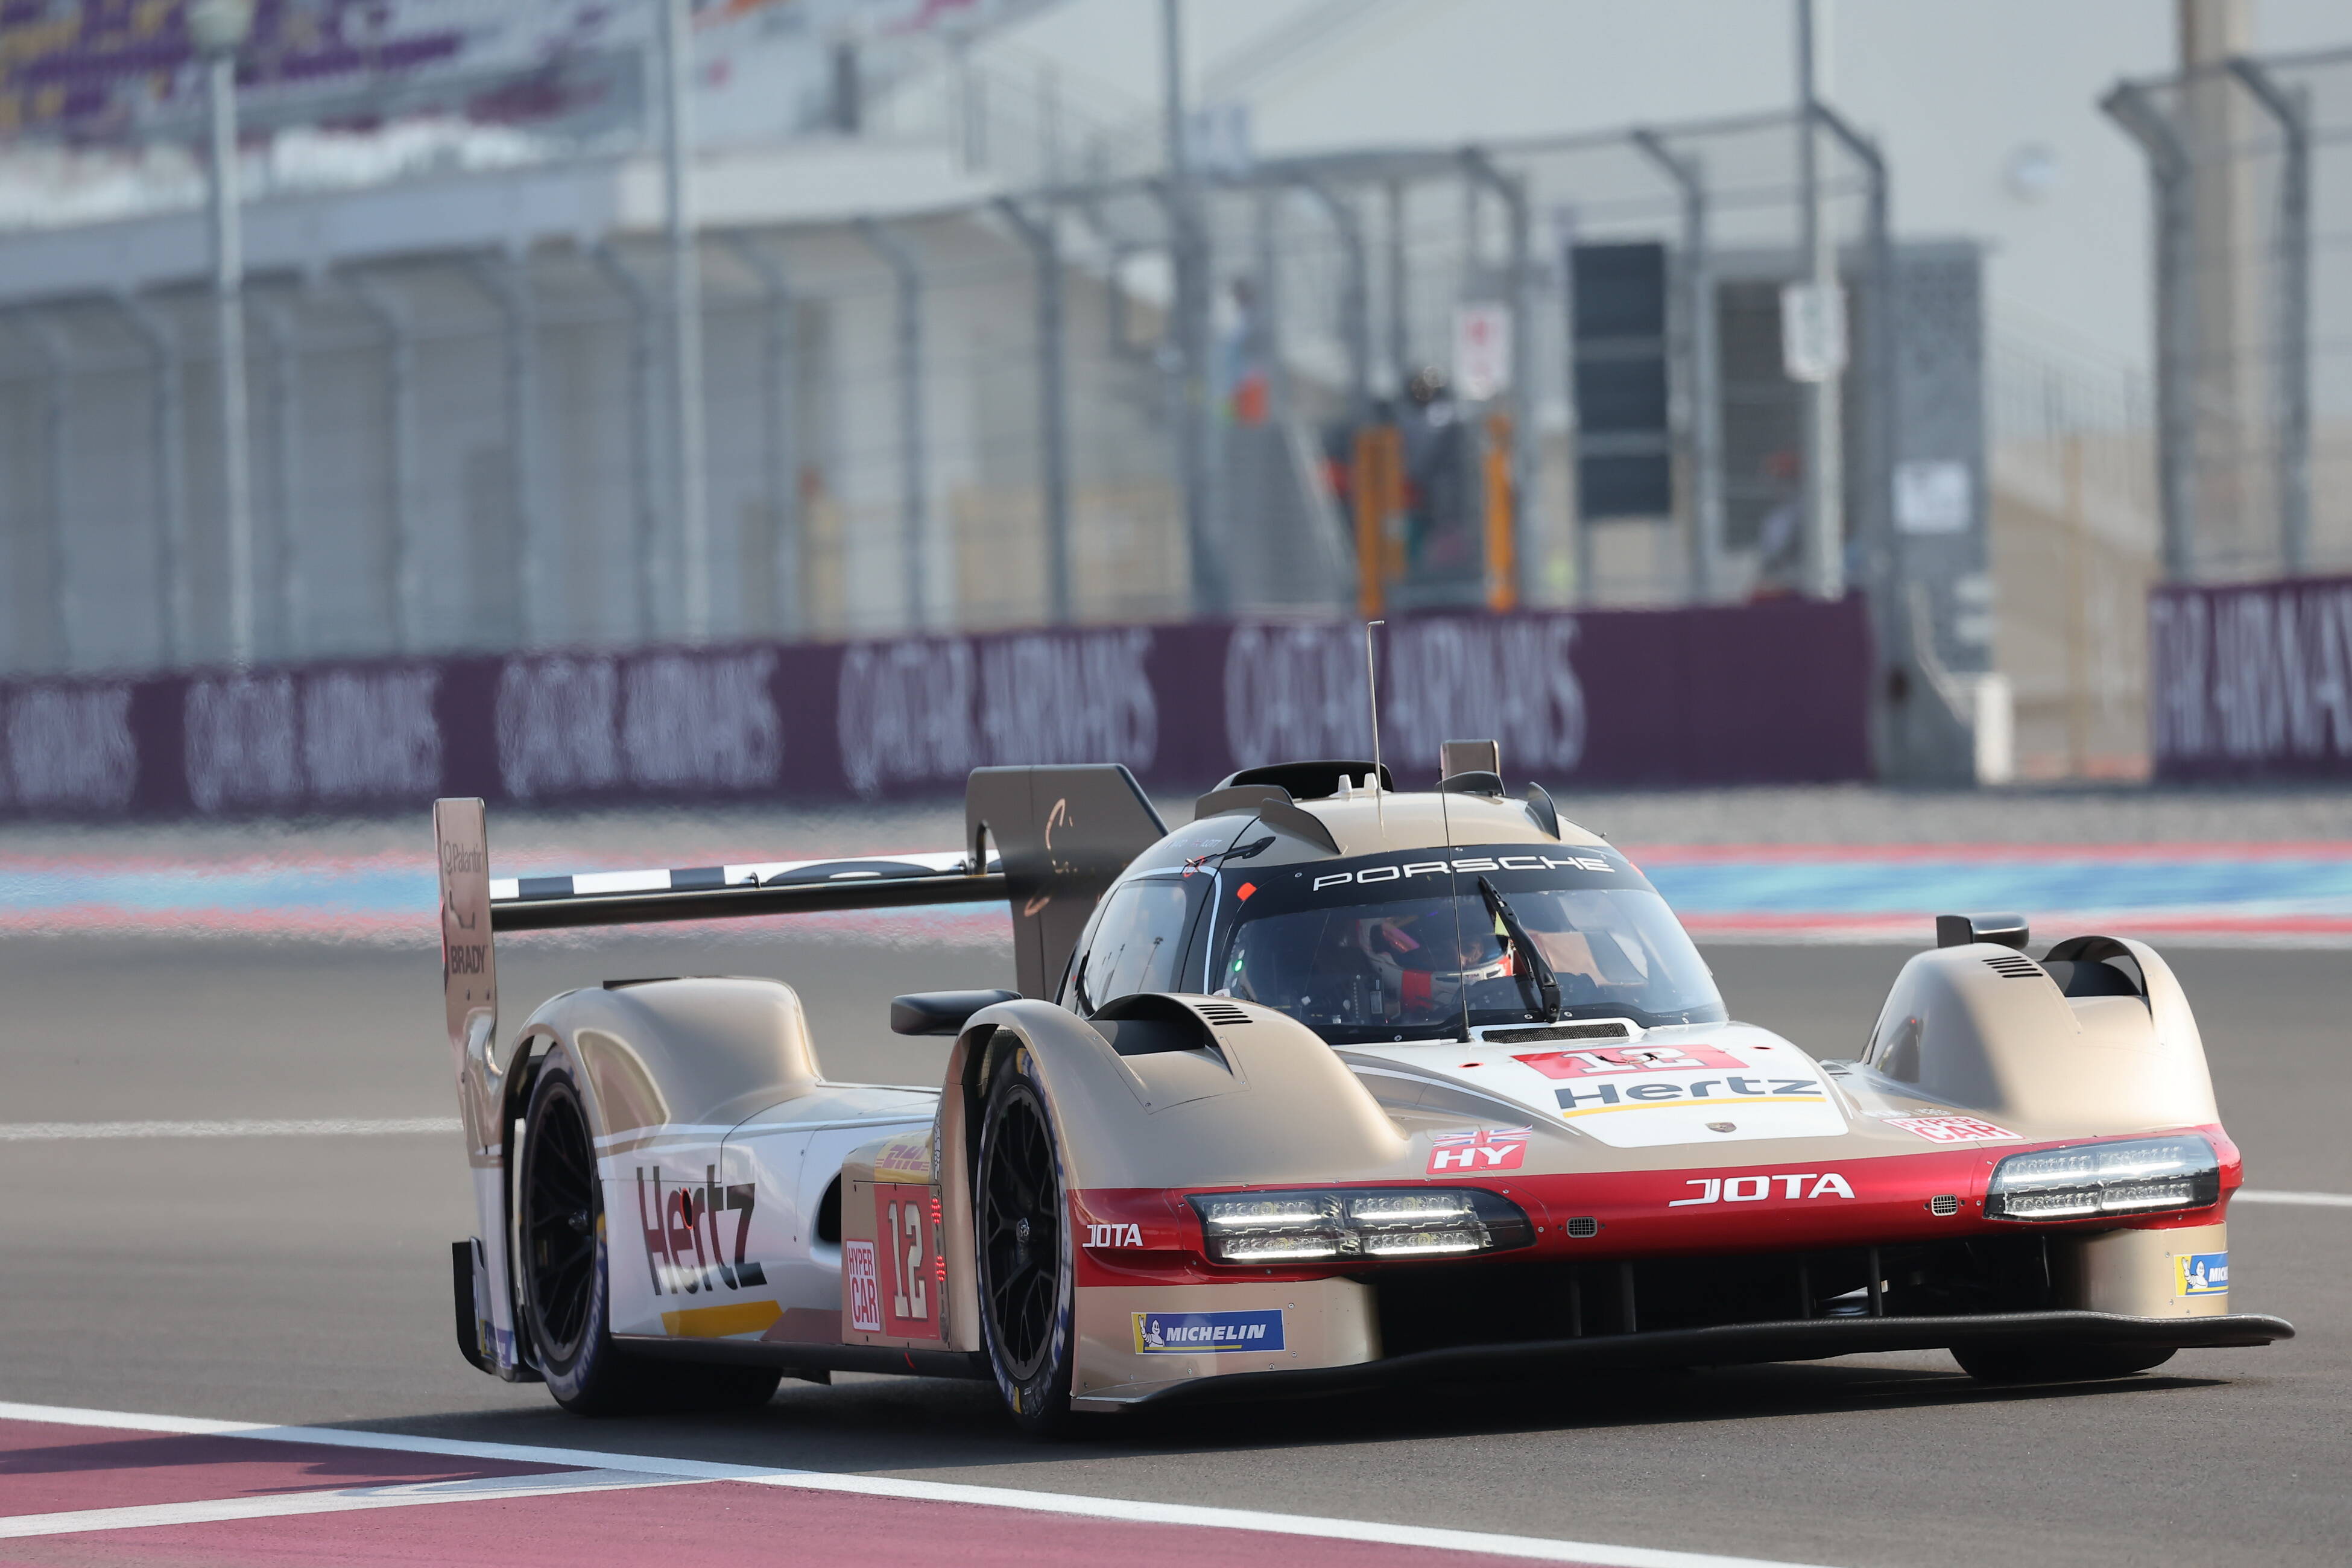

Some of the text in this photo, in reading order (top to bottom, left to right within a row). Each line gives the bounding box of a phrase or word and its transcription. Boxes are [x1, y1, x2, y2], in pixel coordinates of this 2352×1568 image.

[452, 842, 482, 873] Palantir
[1313, 855, 1616, 891] PORSCHE
[450, 945, 485, 975] BRADY
[1560, 1046, 1709, 1074] 12
[1554, 1076, 1822, 1110] Hertz
[1892, 1118, 1979, 1128] HYPER
[1914, 1124, 2013, 1140] CAR
[1432, 1144, 1520, 1169] HY
[1668, 1172, 1856, 1207] JOTA
[636, 1164, 768, 1296] Hertz
[1082, 1223, 1143, 1248] JOTA
[847, 1247, 873, 1276] HYPER
[888, 1200, 929, 1319] 12
[851, 1279, 879, 1324] CAR
[1165, 1323, 1266, 1341] MICHELIN
